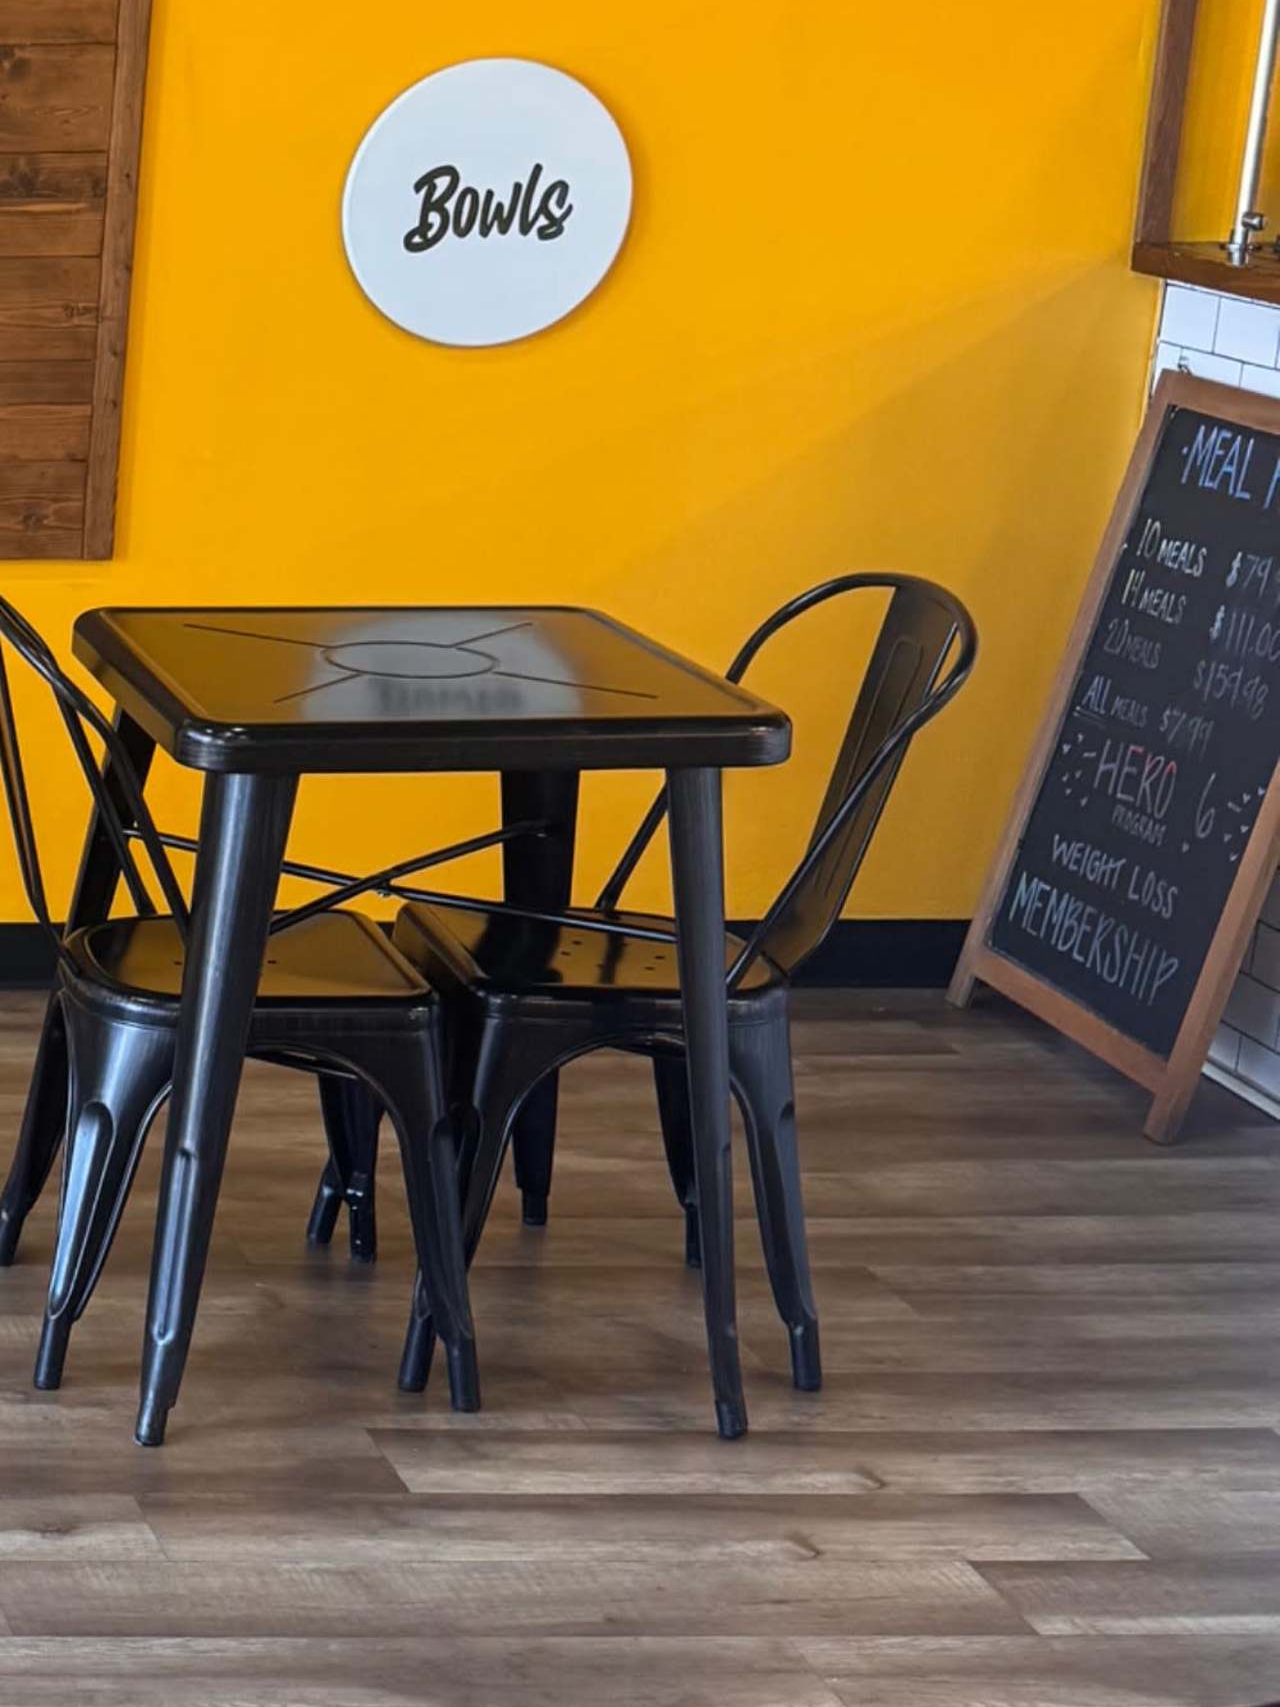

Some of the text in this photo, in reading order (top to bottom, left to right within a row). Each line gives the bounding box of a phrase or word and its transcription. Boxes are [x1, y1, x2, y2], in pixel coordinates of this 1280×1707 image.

[402, 162, 574, 254] Bowls
[1179, 424, 1255, 501] MEAL
[1136, 517, 1162, 559] 10
[1156, 538, 1208, 578] MEALS
[1138, 588, 1188, 625] MEALS
[1121, 634, 1162, 670] MEALS
[1080, 673, 1113, 715] ALL
[1109, 695, 1149, 729] MEALS
[1093, 738, 1178, 821] HERO
[1110, 803, 1168, 846] PROGRAM
[1050, 833, 1179, 920] WEIGHT LOSS
[1007, 870, 1180, 1007] MEMBERSHIP
